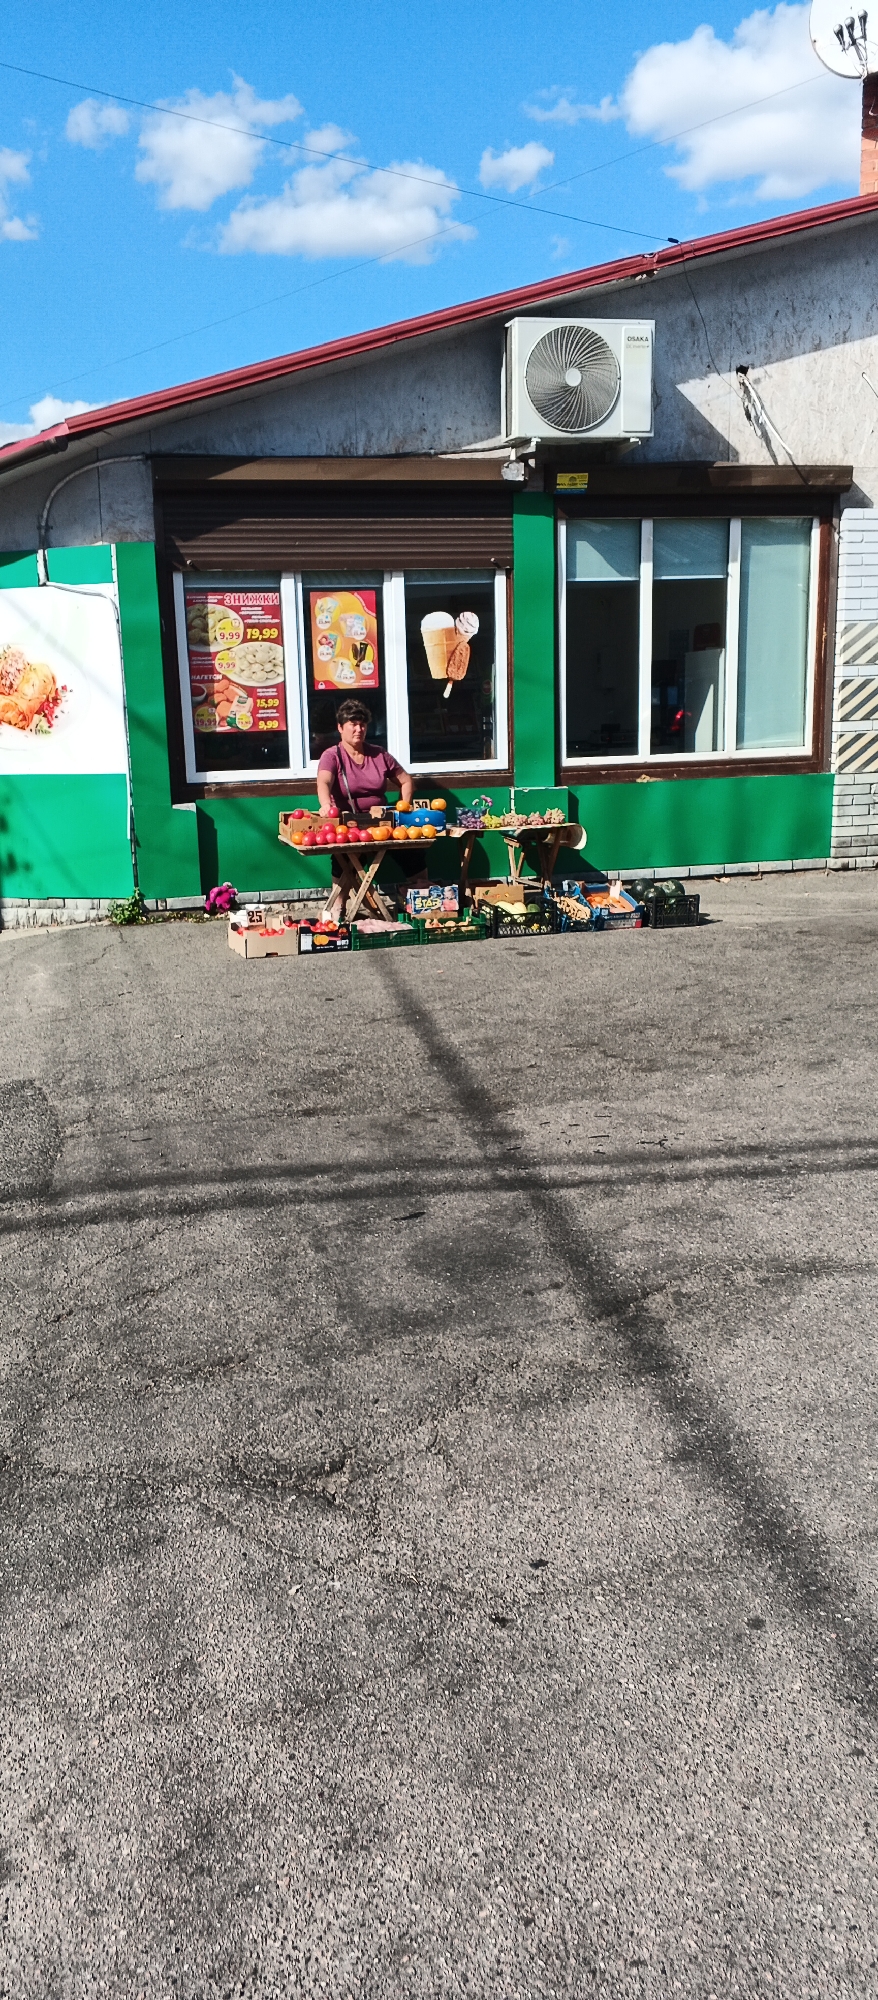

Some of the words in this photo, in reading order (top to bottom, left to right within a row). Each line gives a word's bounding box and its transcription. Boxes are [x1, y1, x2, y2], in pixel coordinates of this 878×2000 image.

[224, 592, 280, 605] ЗНИЖКИ
[246, 628, 279, 641] 19,99
[256, 698, 280, 709] 15,99
[258, 720, 279, 731] 9,99
[415, 897, 442, 909] STAR
[247, 910, 263, 923] 25
